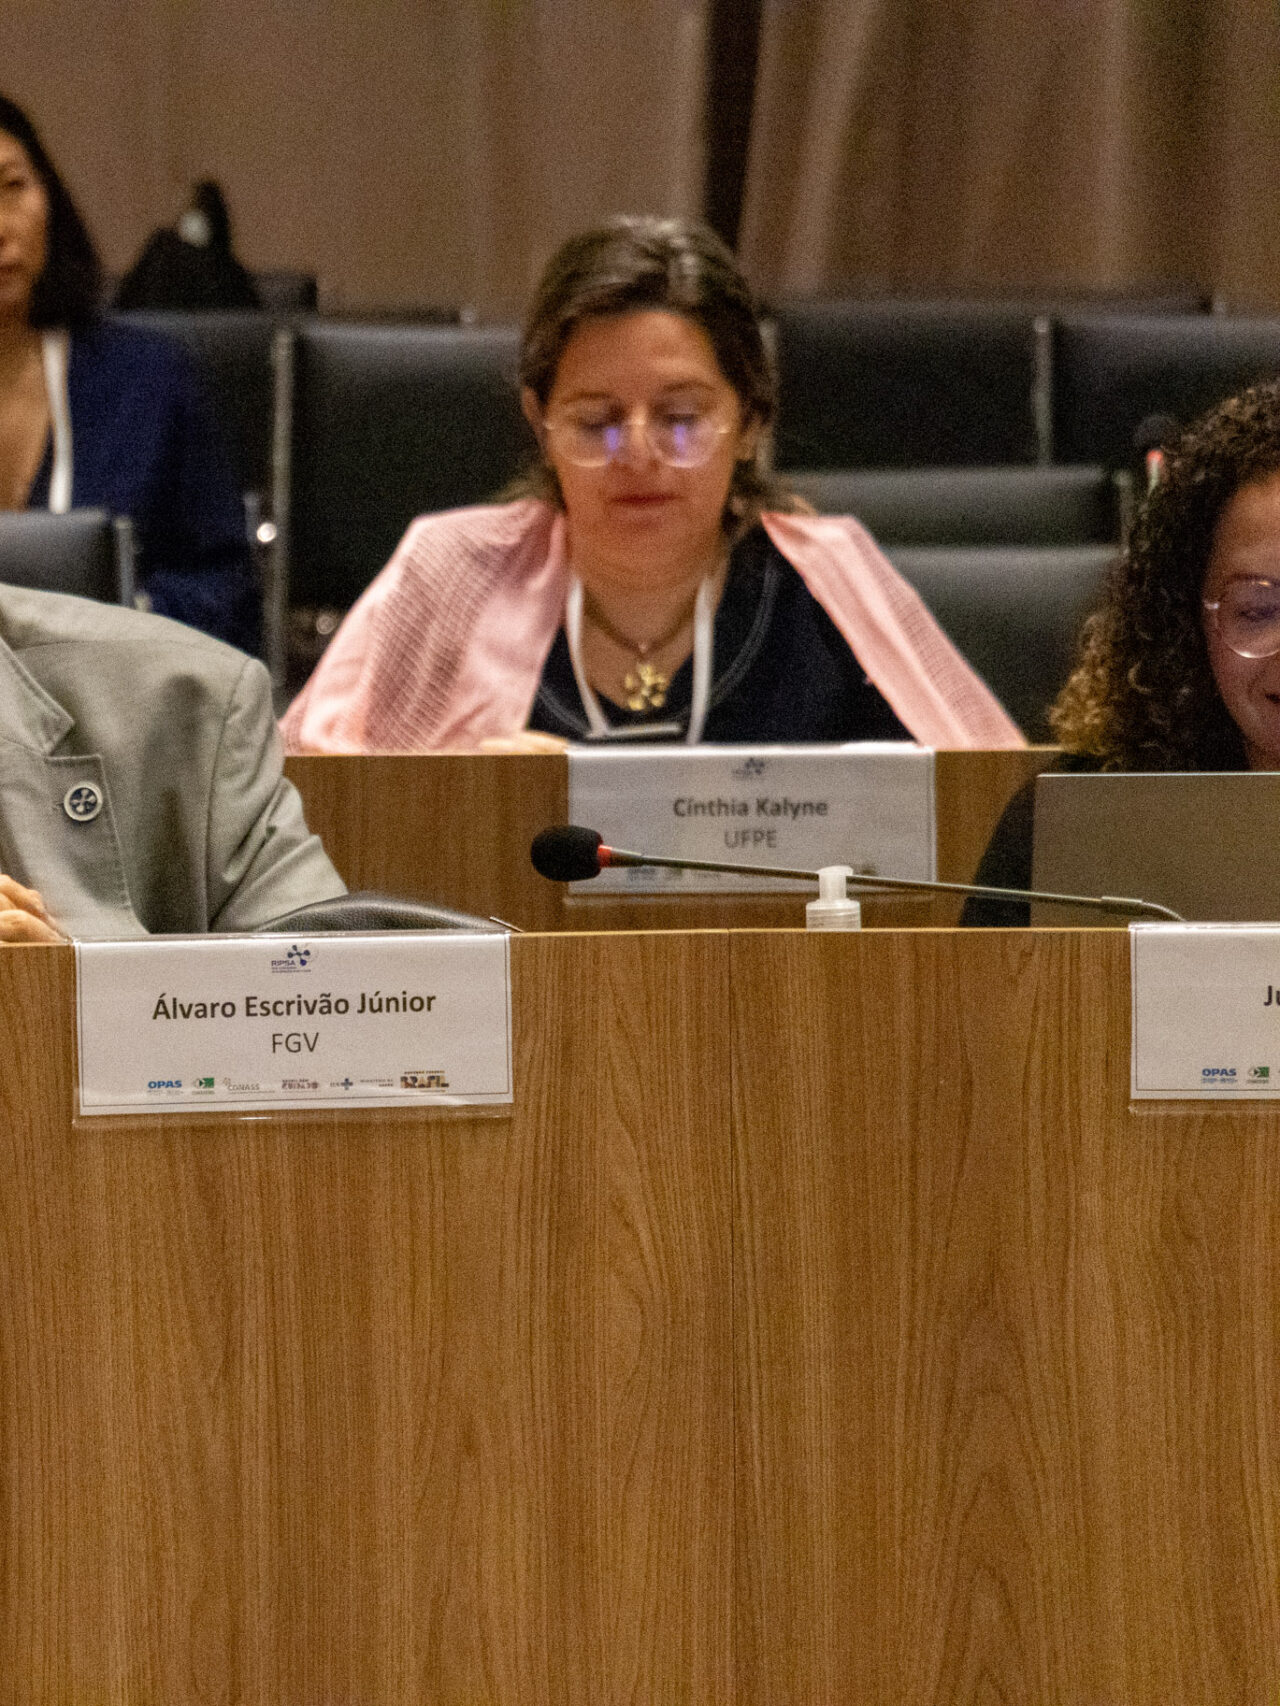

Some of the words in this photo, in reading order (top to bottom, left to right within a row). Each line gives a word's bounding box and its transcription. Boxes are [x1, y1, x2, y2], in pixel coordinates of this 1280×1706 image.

[756, 797, 828, 820] Kalyne
[724, 828, 778, 848] UFPE
[152, 992, 237, 1020] Álvaro
[245, 992, 350, 1018] Escrivão
[356, 990, 437, 1015] Júnior
[271, 1032, 320, 1054] FGV
[1201, 1067, 1238, 1077] OPAS
[147, 1079, 183, 1089] OPAS
